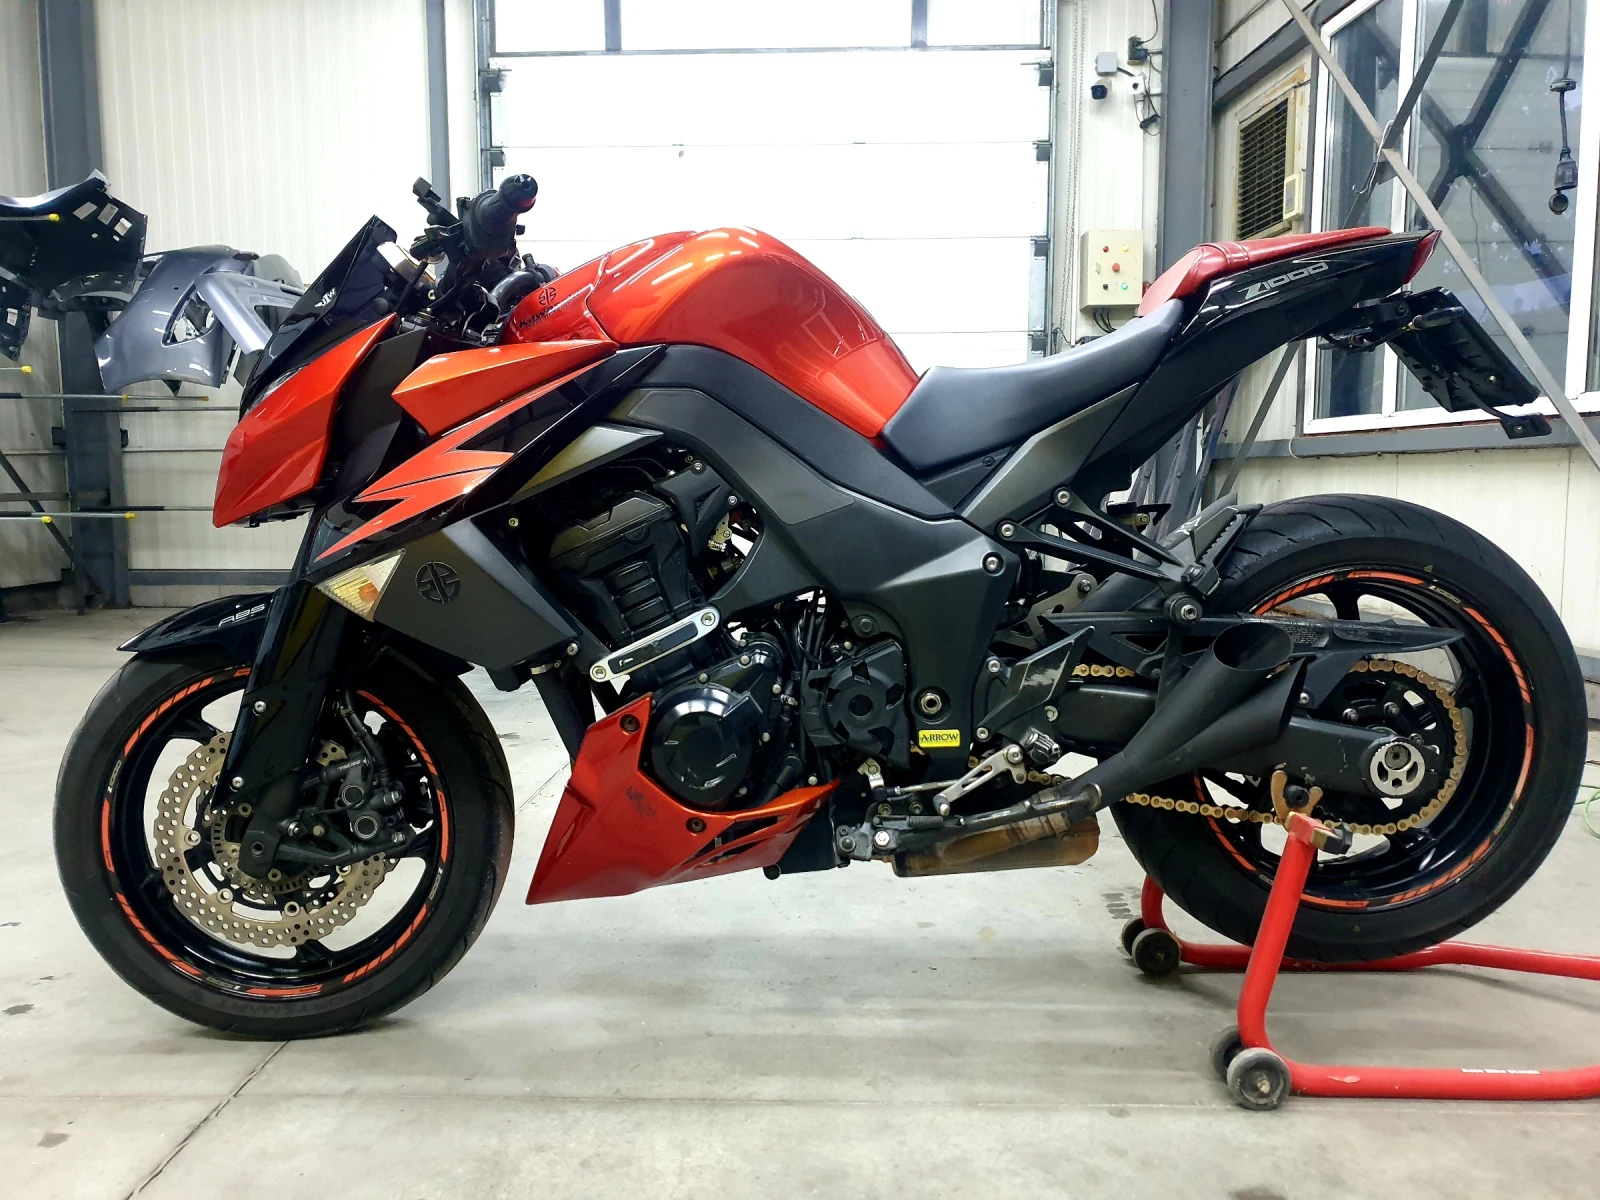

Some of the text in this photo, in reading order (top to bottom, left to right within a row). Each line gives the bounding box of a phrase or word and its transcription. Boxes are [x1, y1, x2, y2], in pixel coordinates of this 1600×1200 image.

[1237, 262, 1329, 300] Z1000
[519, 289, 580, 329] Kawa
[217, 603, 266, 628] ABS
[919, 733, 959, 743] ARROW
